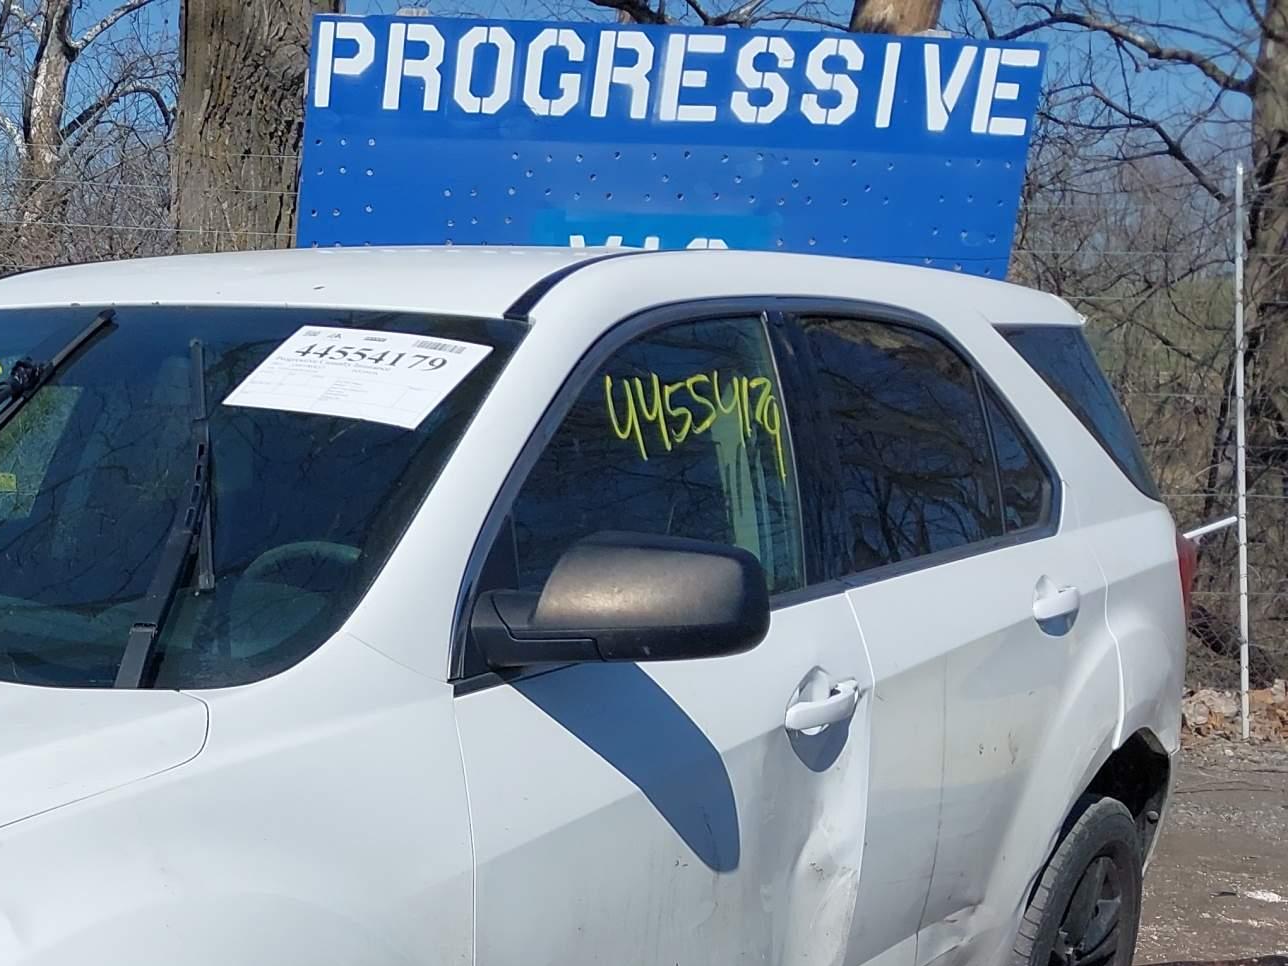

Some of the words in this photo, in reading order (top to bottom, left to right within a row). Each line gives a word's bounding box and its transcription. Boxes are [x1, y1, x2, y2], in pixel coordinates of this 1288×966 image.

[314, 20, 1040, 136] PROGRESSIVE
[294, 342, 448, 372] 44554179
[605, 370, 787, 488] 44554179
